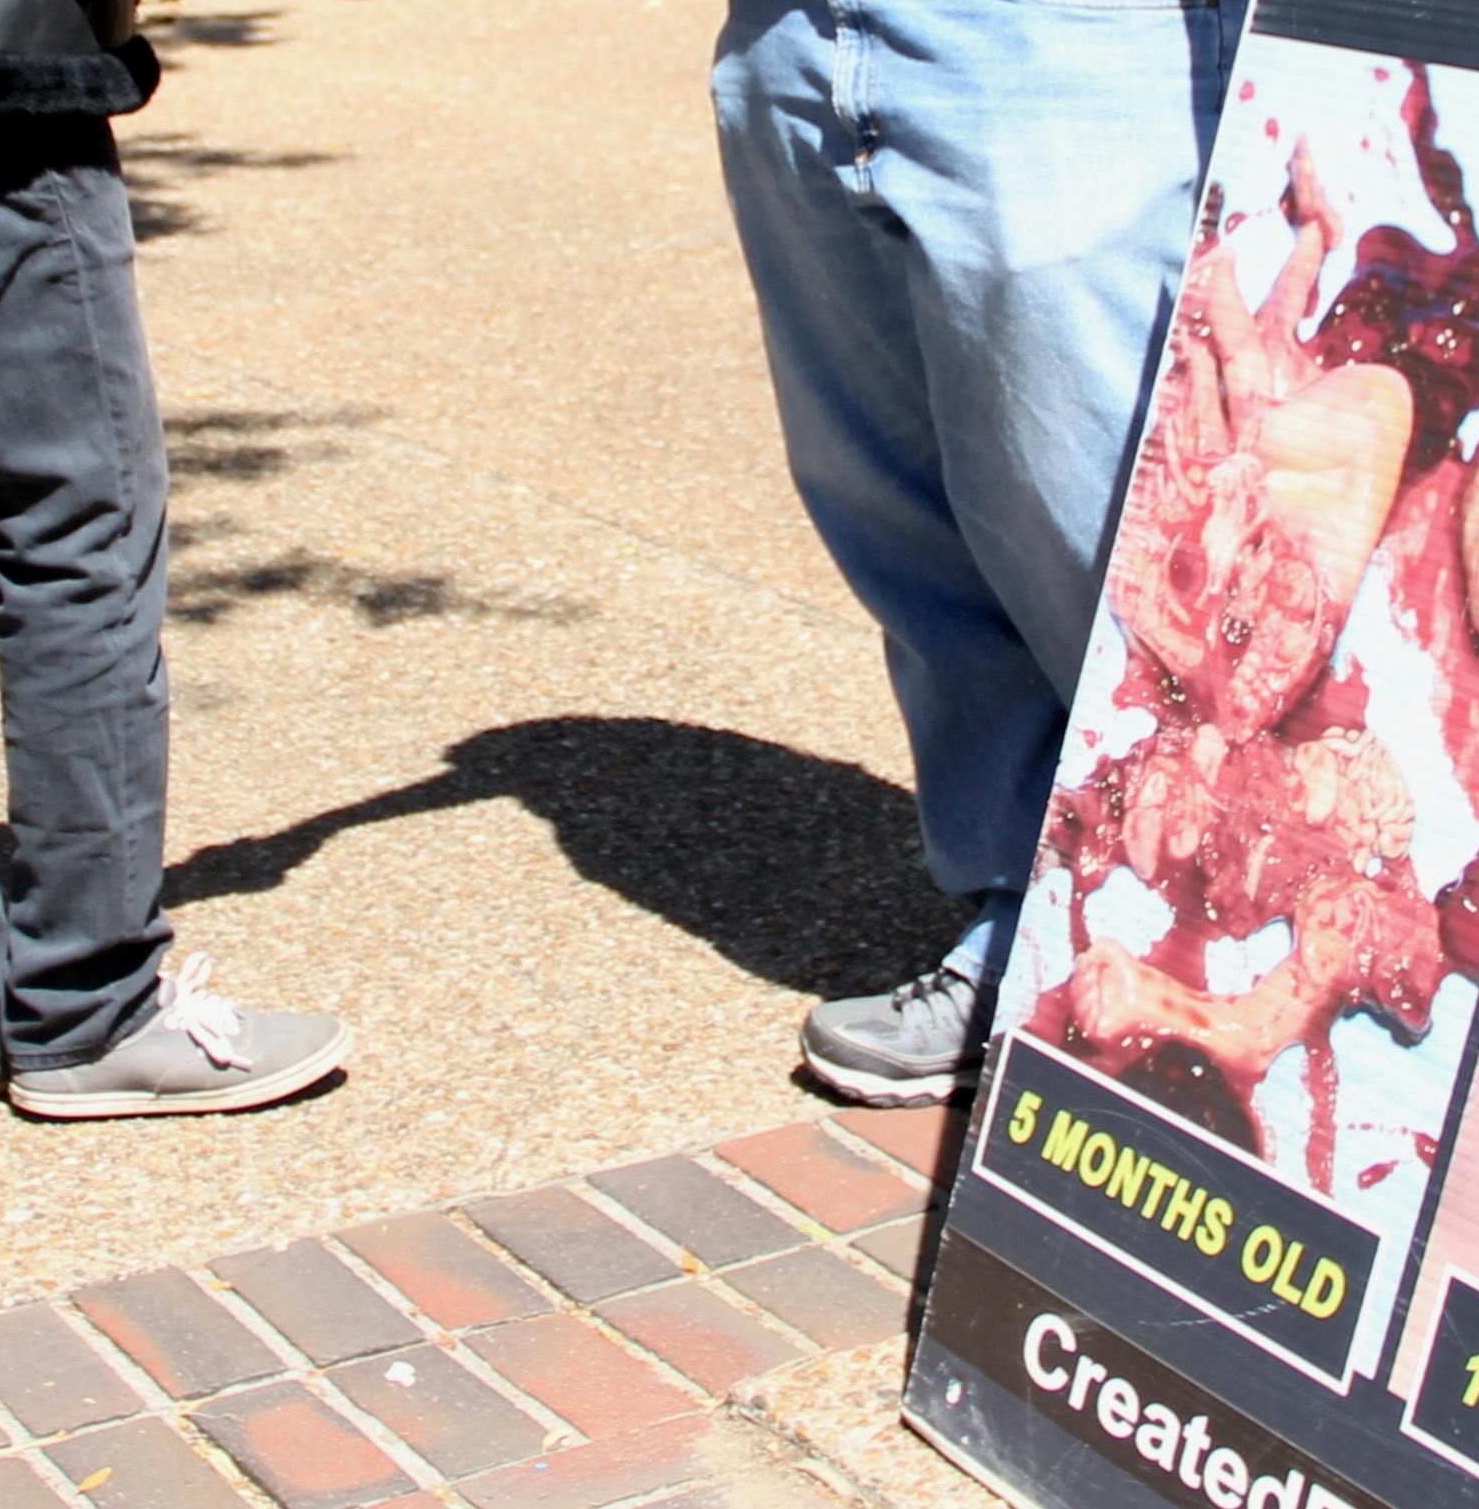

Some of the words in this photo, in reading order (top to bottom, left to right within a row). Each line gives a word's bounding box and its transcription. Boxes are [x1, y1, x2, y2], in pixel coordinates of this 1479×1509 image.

[1006, 1092, 1045, 1145] 5
[1040, 1109, 1237, 1257] MONTHS
[1239, 1226, 1349, 1319] OLD
[1022, 1312, 1359, 1509] Created
